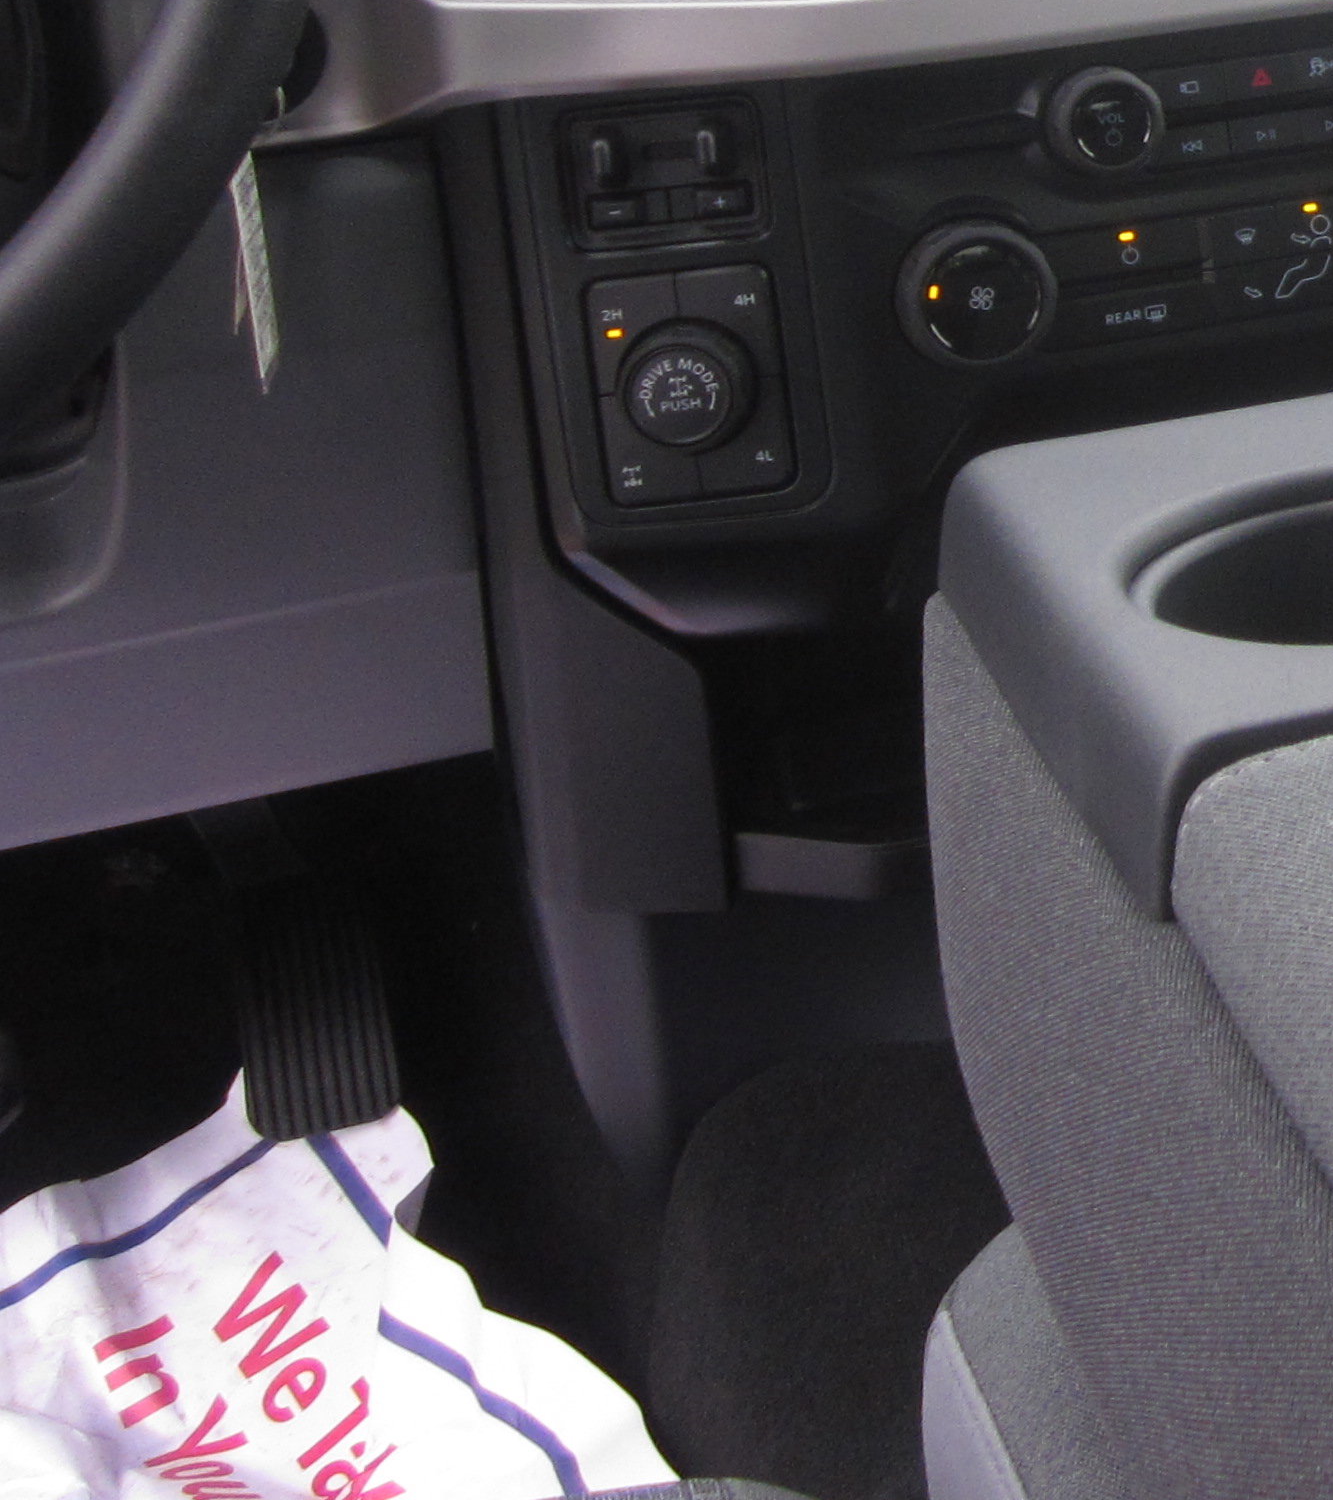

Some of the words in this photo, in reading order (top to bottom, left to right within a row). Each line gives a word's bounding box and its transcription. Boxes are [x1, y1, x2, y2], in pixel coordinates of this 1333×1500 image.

[1098, 112, 1126, 126] VOL
[734, 293, 756, 306] 4H
[600, 308, 623, 322] 2H
[1105, 308, 1143, 326] REAR
[639, 359, 674, 399] DRIVE
[677, 358, 720, 392] MODE
[660, 398, 703, 413] PUSH
[755, 450, 775, 462] 4L
[212, 1250, 331, 1424] We
[93, 1314, 180, 1430] In
